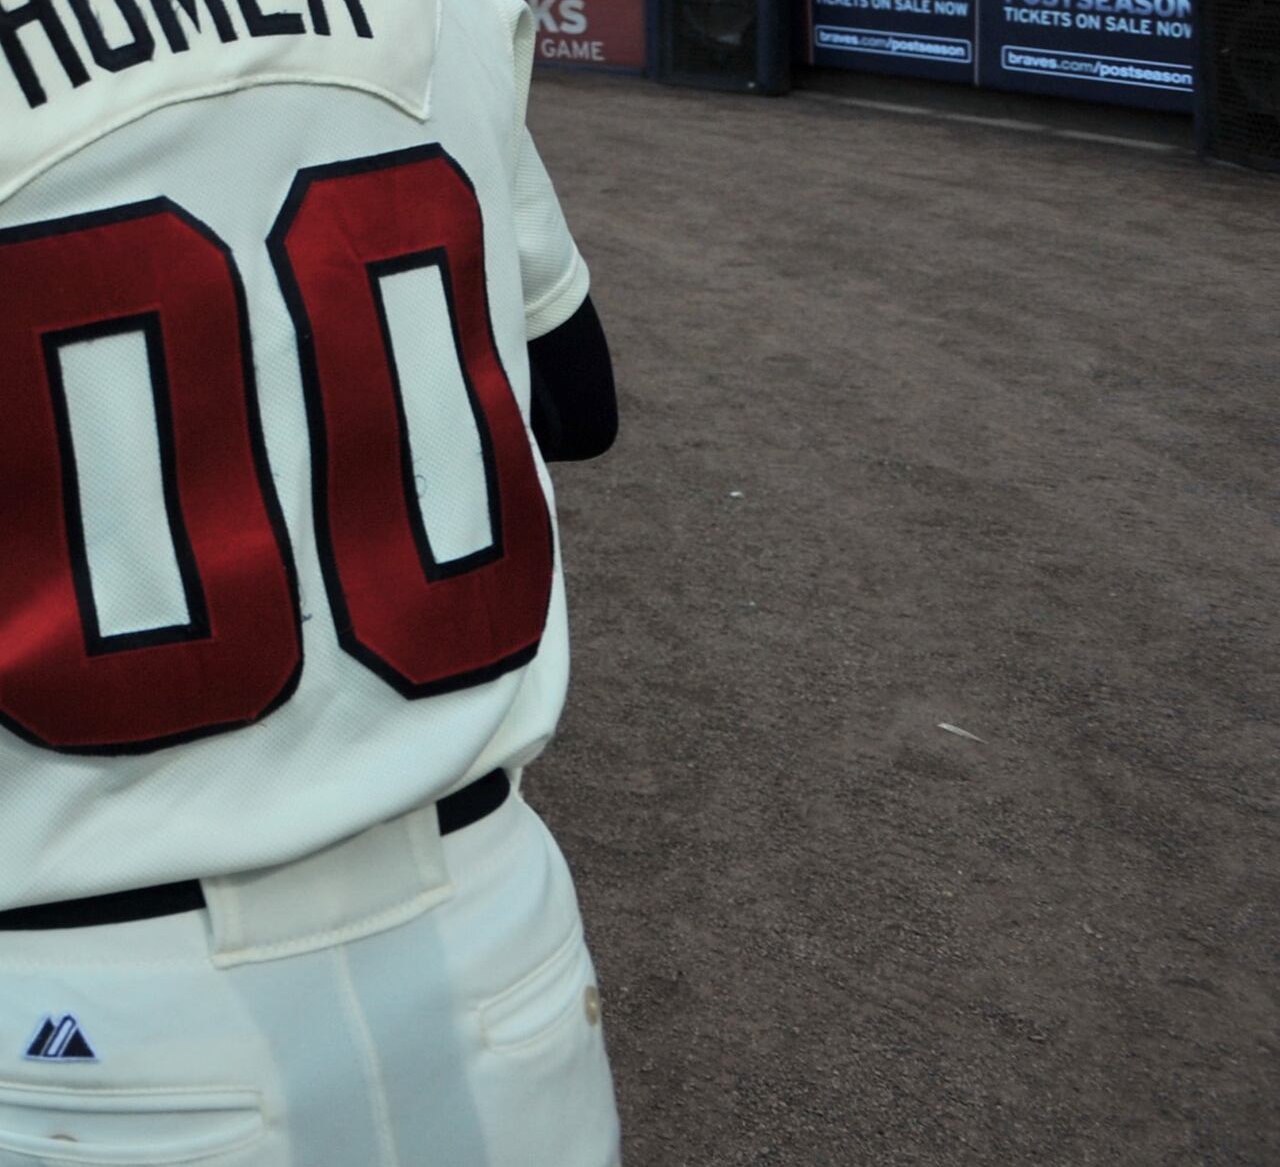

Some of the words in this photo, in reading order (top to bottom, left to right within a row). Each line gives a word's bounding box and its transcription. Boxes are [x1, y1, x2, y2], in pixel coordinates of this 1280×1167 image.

[934, 0, 969, 17] NOW
[1003, 5, 1072, 28] TICKETS
[1075, 13, 1101, 31] ON
[1105, 15, 1153, 35] SALE
[541, 38, 606, 62] GAME
[818, 30, 966, 57] braves.com/postseason
[1007, 51, 1193, 85] braves.com/postseason
